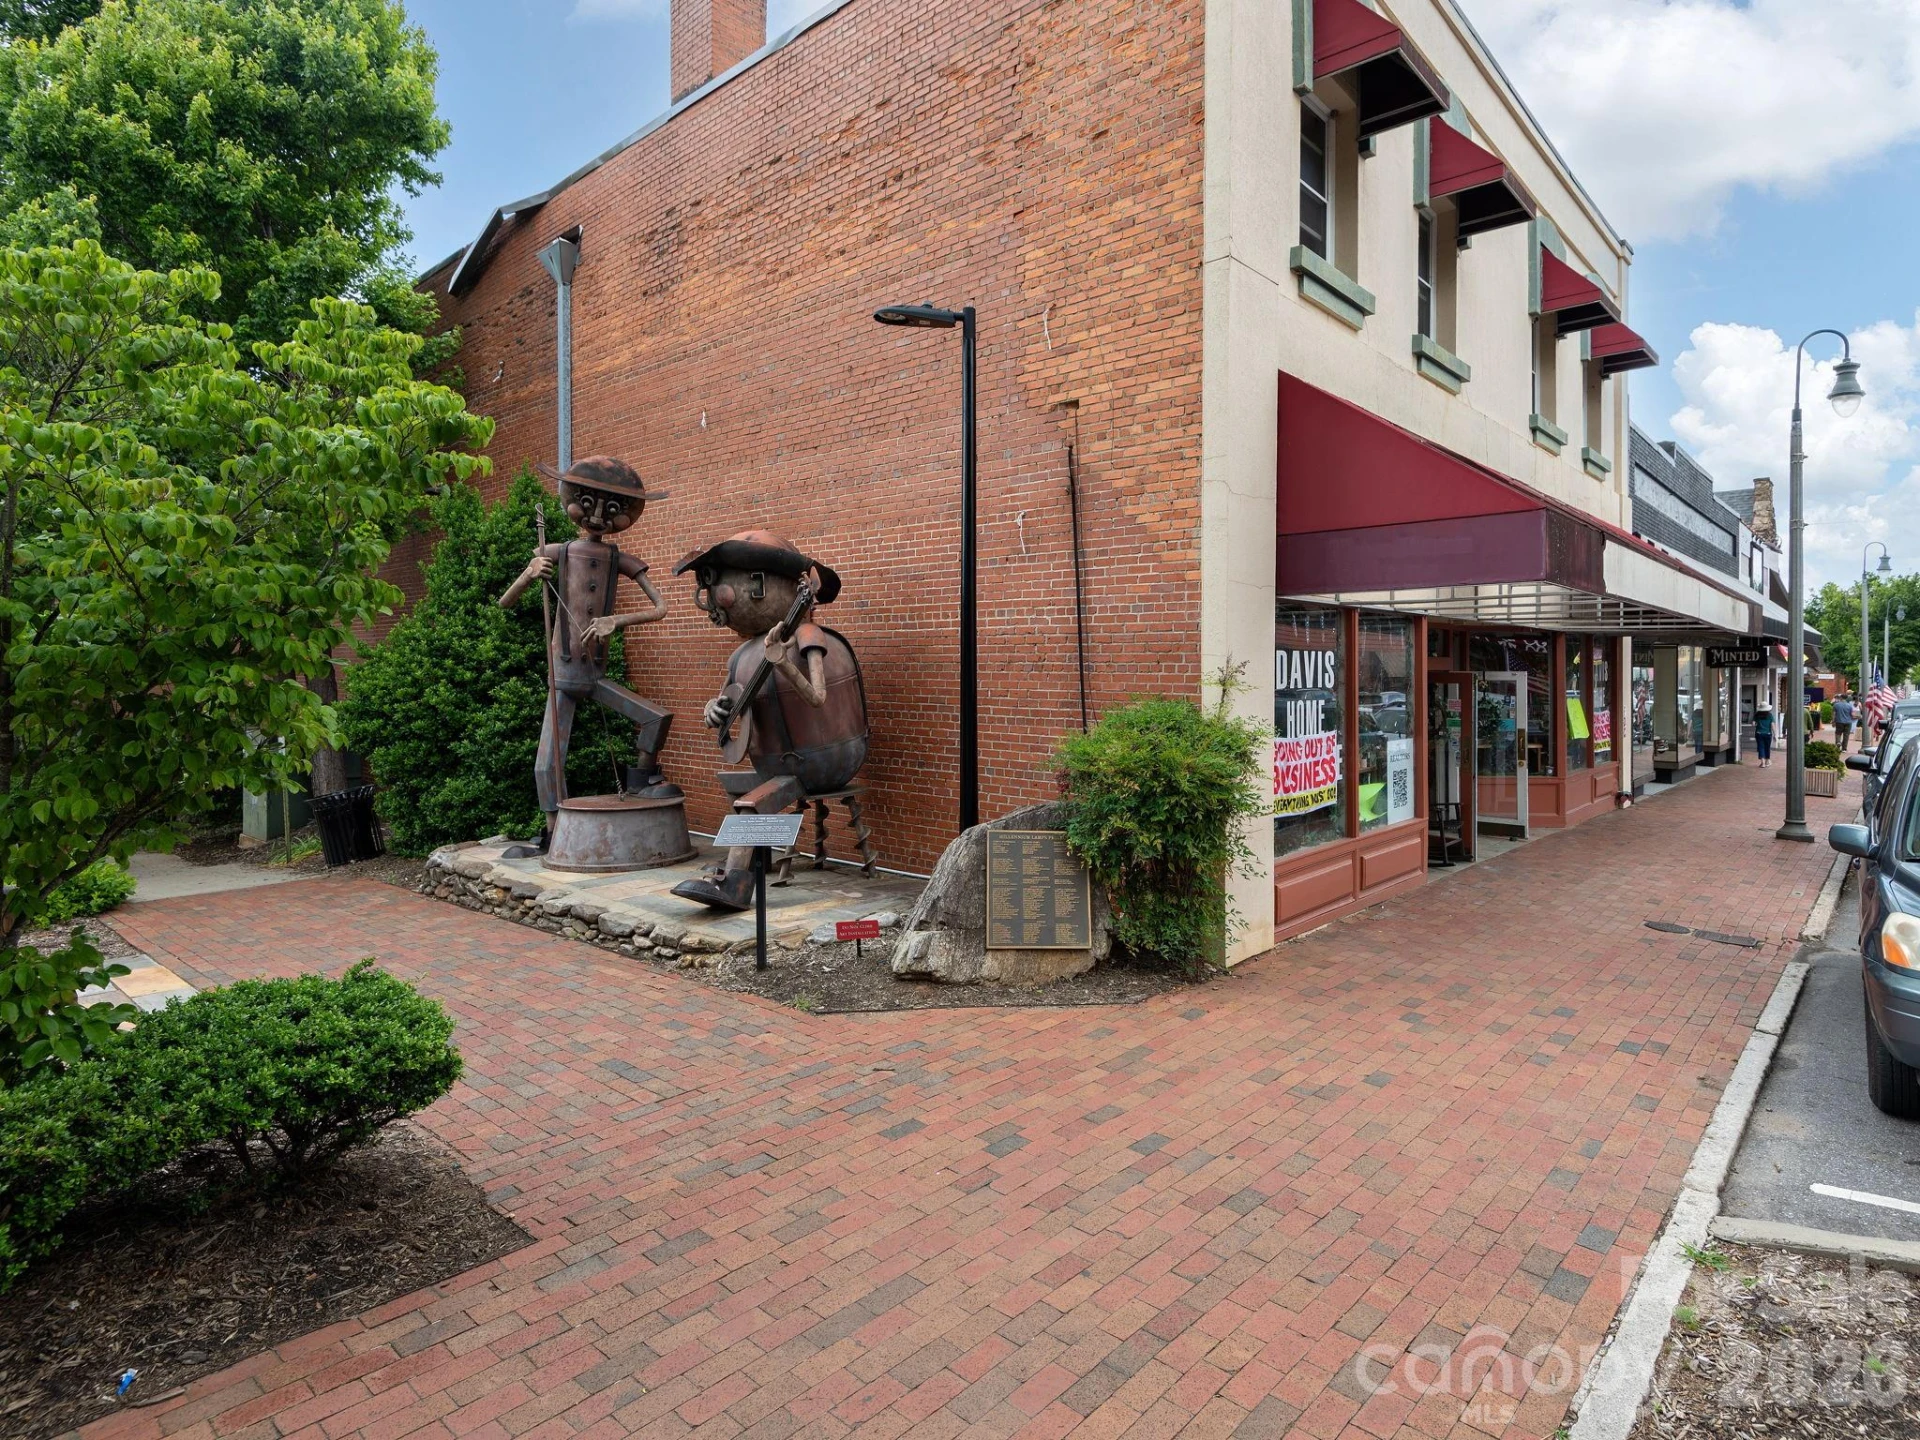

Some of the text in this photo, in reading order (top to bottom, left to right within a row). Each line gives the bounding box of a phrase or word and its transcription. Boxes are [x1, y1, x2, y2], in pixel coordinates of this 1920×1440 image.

[1276, 650, 1335, 689] DAVIS
[1711, 649, 1760, 664] MINTED
[1287, 700, 1325, 738] HOME
[1305, 738, 1323, 759] OUT
[1274, 756, 1336, 795] BUSINESS
